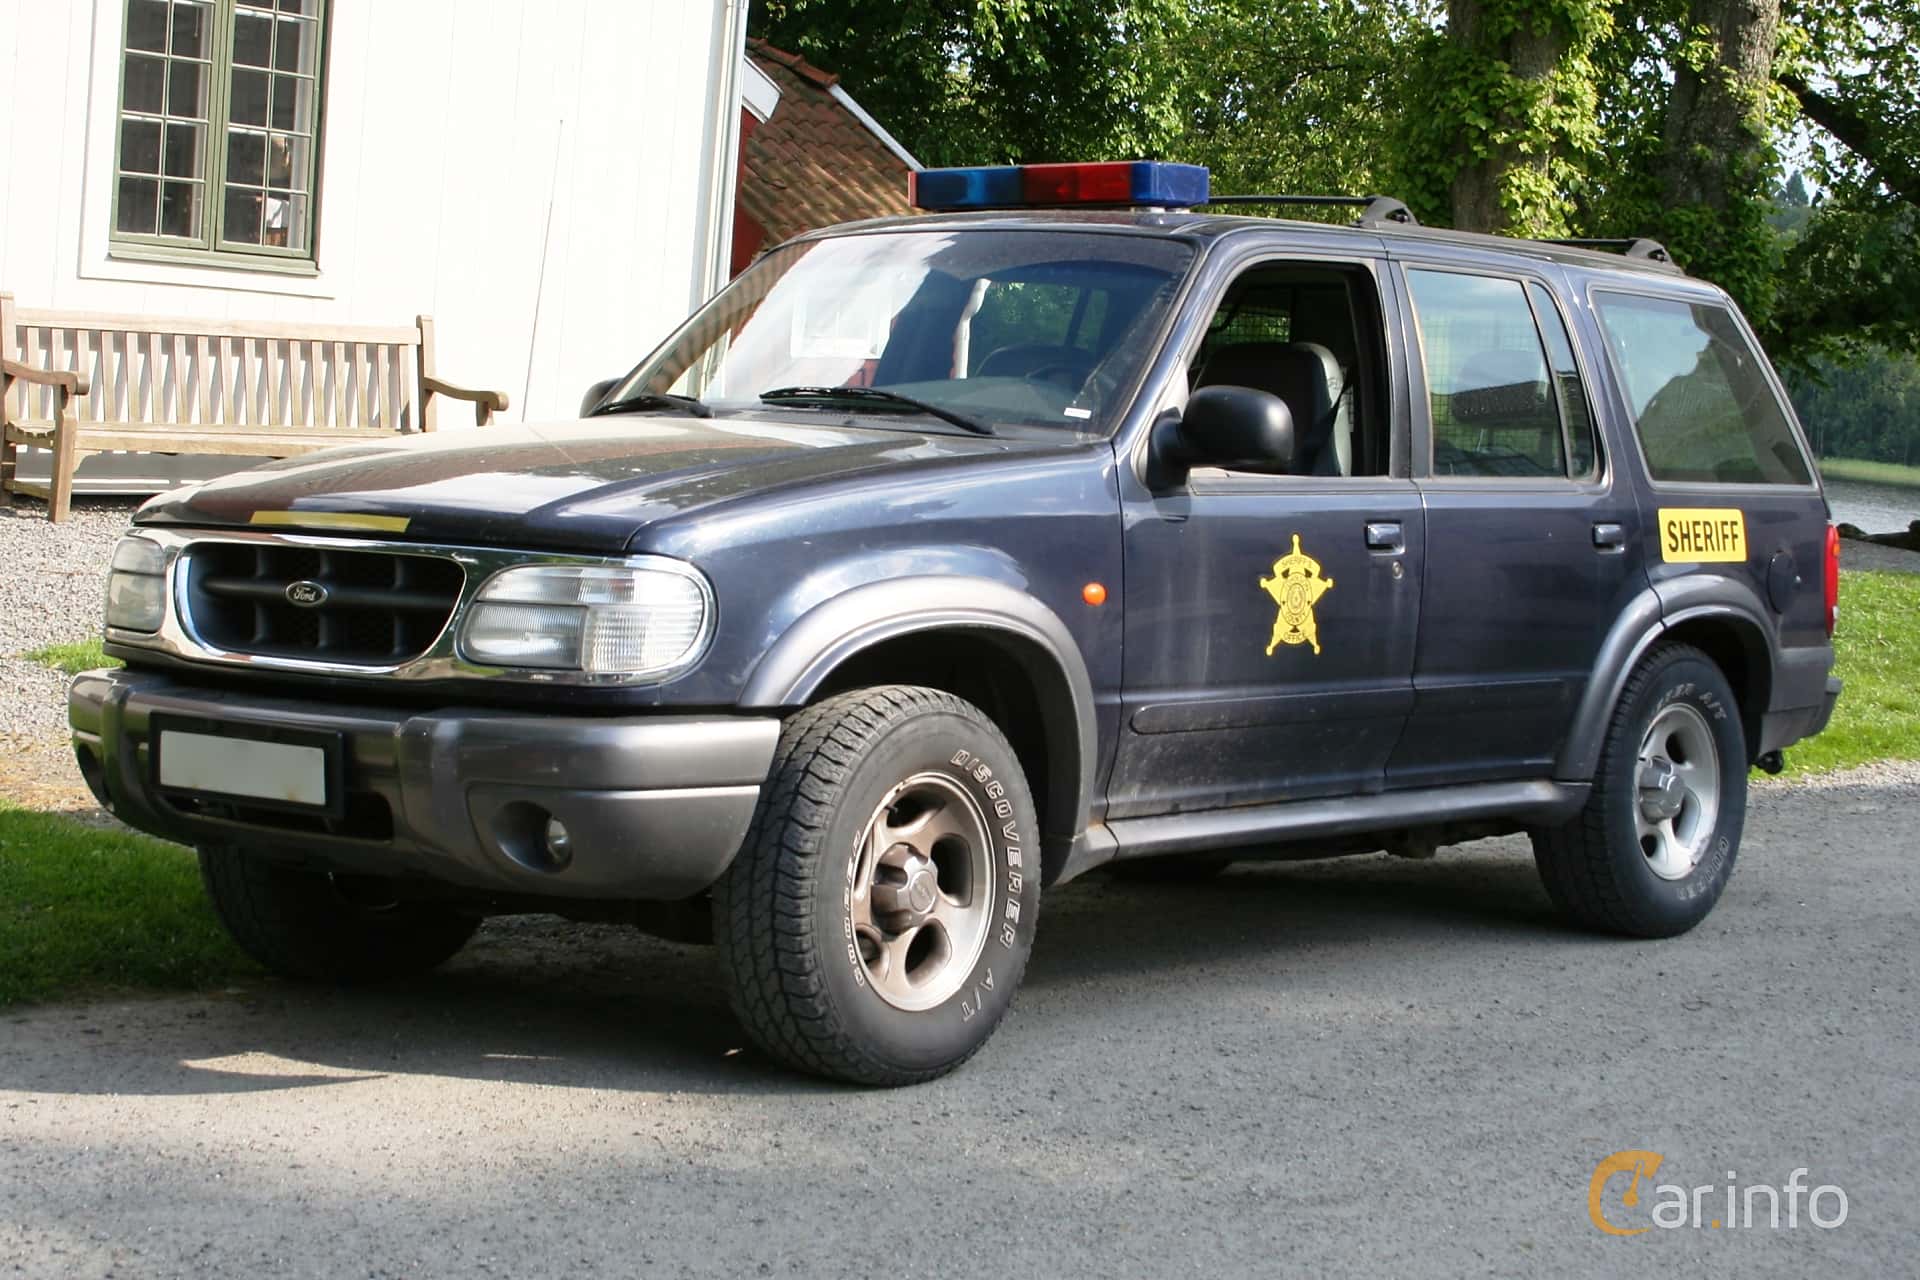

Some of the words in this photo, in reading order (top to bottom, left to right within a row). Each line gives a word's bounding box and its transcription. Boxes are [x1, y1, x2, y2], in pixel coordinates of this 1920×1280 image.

[1667, 520, 1739, 552] SHERIFF
[293, 585, 317, 601] Ford
[951, 749, 1022, 948] DISCOVERER
[960, 968, 994, 1021] A/T
